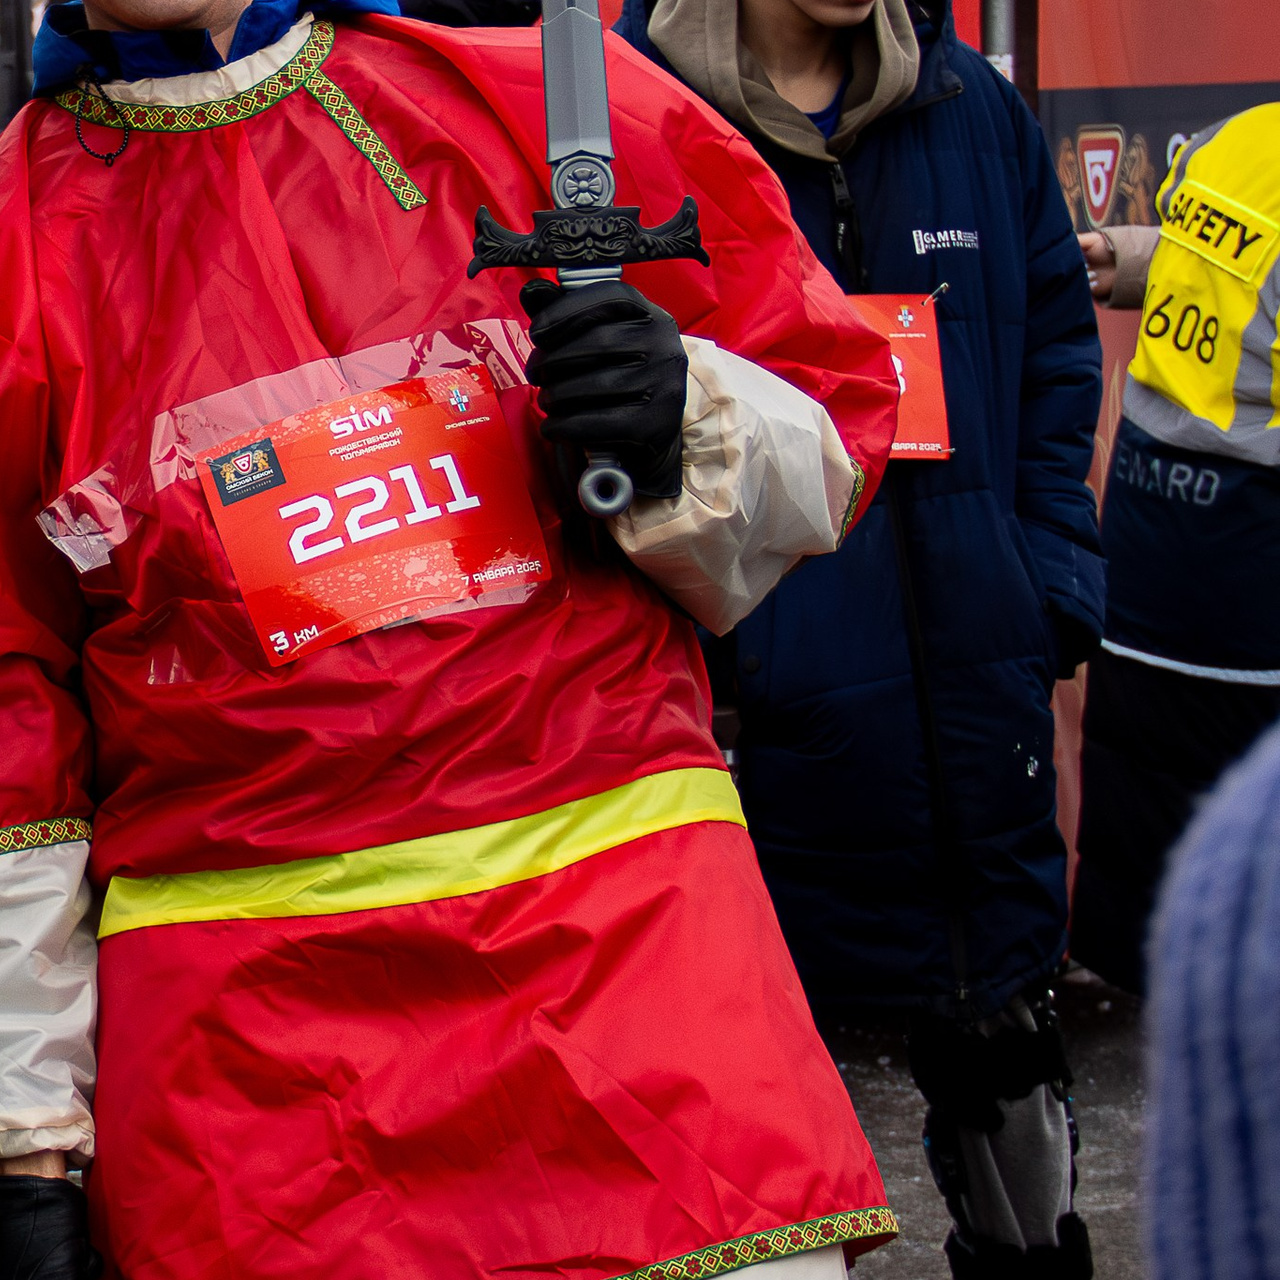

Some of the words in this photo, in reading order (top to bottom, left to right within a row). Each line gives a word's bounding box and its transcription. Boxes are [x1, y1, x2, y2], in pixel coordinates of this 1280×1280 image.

[1165, 192, 1264, 261] SAFETY
[328, 427, 403, 457] РОЖДЕСТВЕНСКИЙ
[340, 438, 401, 461] ПОЛУМАРАФОН
[278, 452, 481, 565] 2211
[461, 575, 469, 586] 7
[472, 565, 515, 584] ЯНВАРЯ
[516, 560, 542, 575] 2025
[269, 630, 290, 653] 3
[293, 624, 319, 644] КМ
